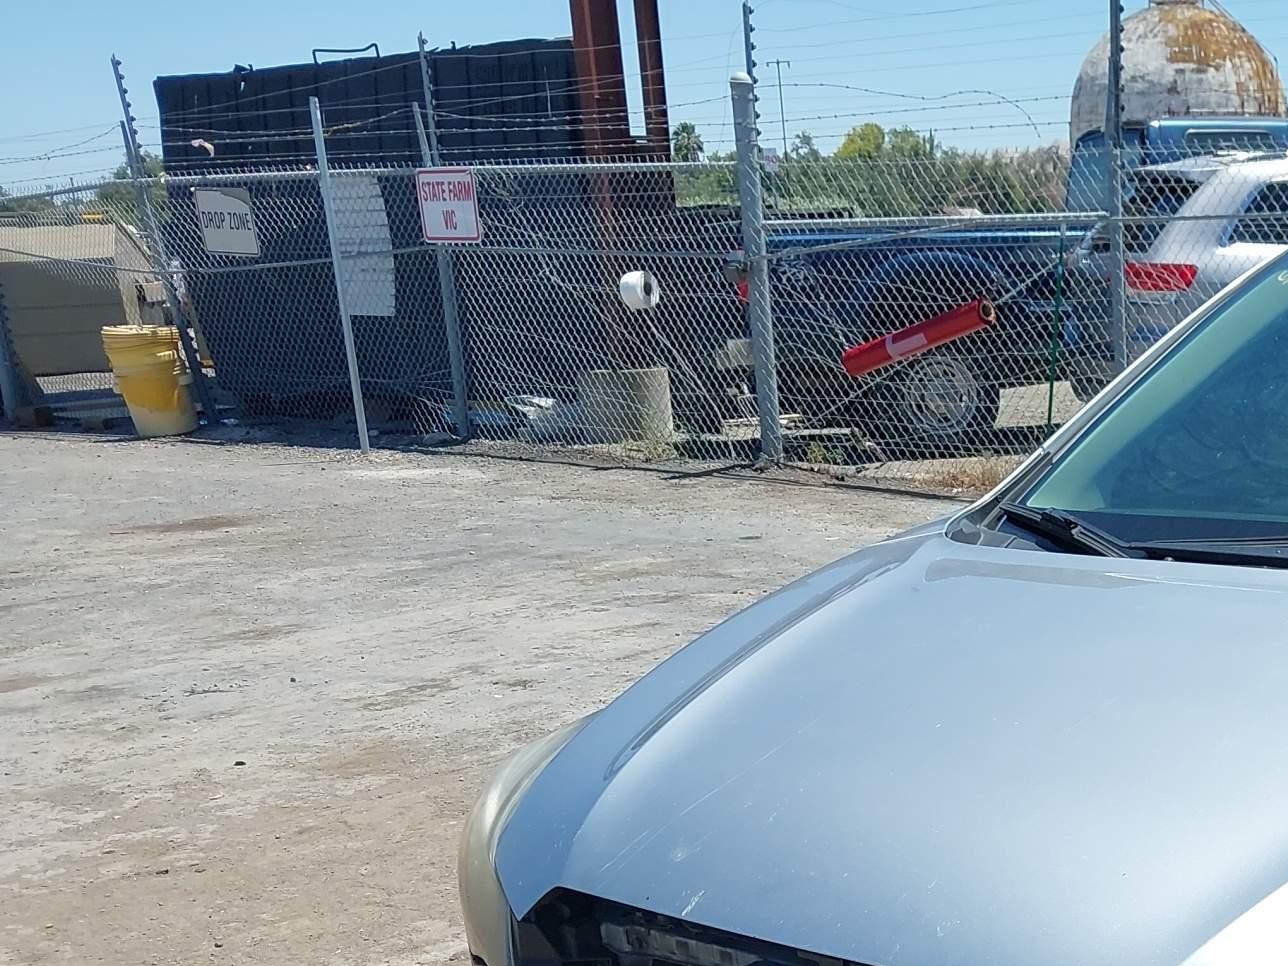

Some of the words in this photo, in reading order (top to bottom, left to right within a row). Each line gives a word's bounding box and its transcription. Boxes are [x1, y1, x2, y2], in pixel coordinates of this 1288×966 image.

[421, 181, 447, 202] STATE
[447, 181, 472, 202] FARM
[201, 211, 226, 230] DROP
[227, 212, 252, 231] ZONE
[442, 209, 458, 231] VIC
